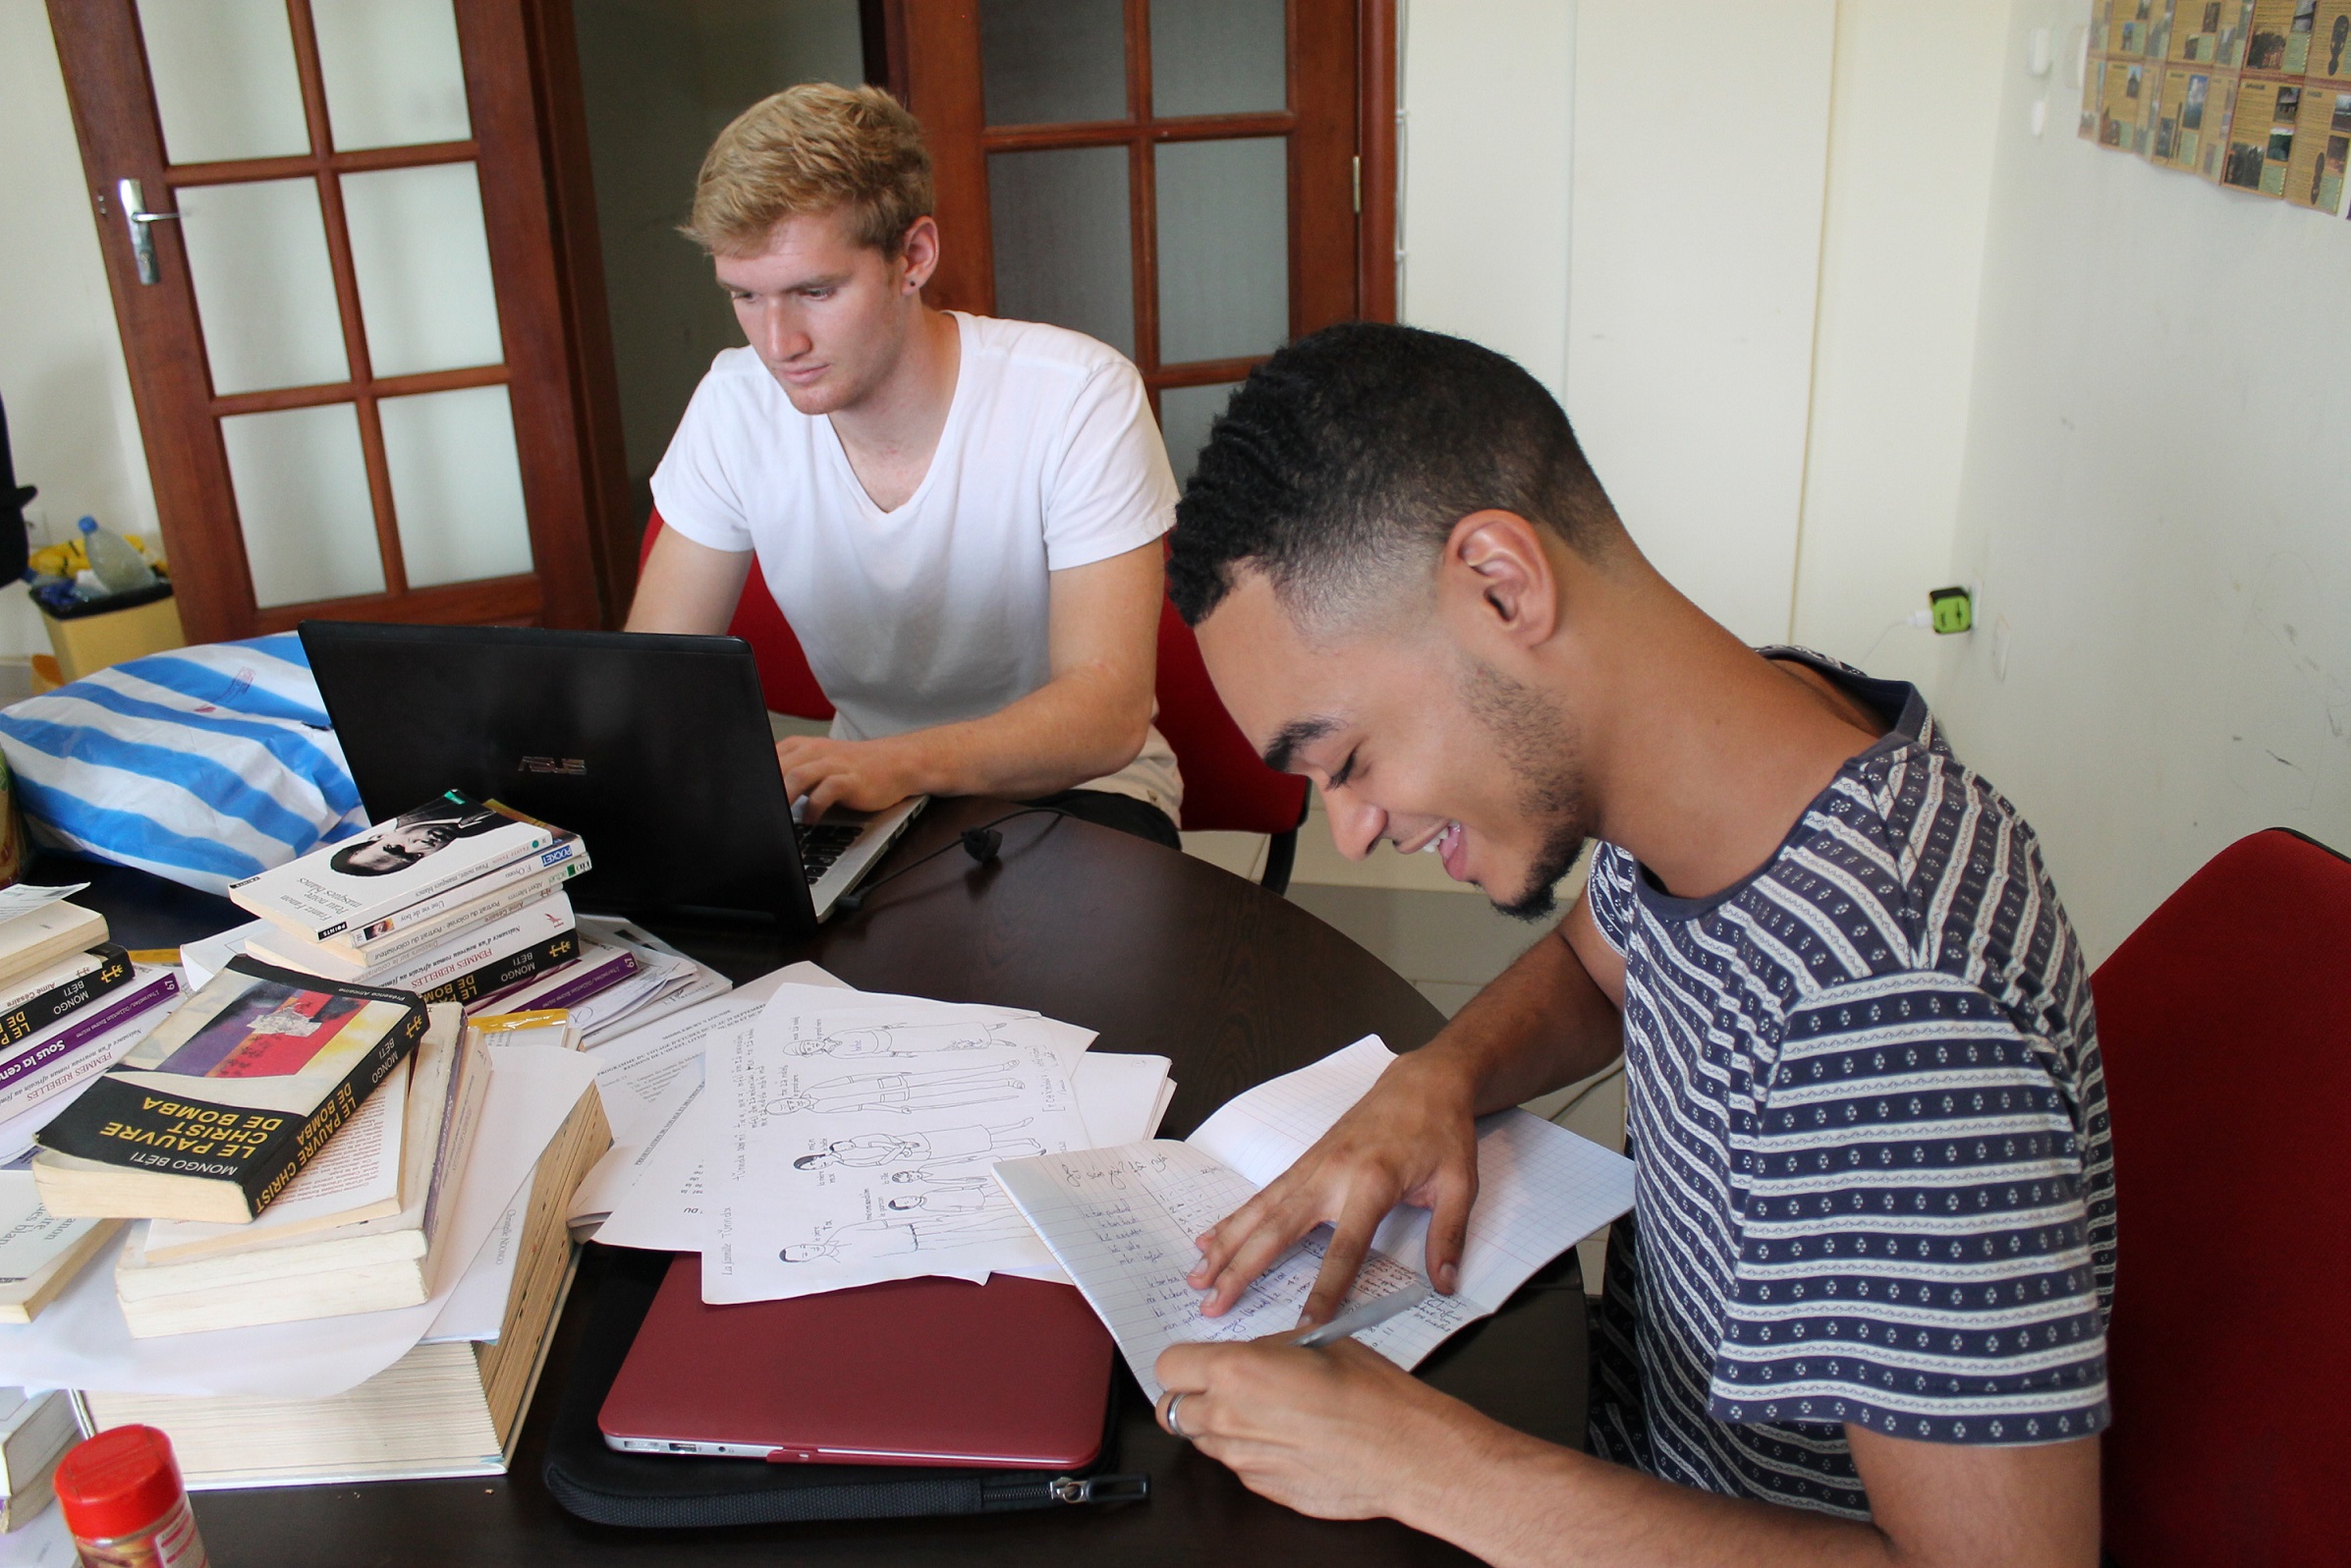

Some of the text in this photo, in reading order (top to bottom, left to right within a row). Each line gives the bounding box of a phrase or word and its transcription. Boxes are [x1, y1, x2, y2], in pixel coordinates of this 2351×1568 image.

[518, 756, 588, 775] ASUS
[541, 845, 573, 865] POCKET
[298, 876, 363, 908] masques blancs
[416, 886, 434, 897] blancs
[280, 893, 333, 922] Frantz Fanon
[328, 901, 349, 916] Peau
[400, 912, 413, 922] boy
[478, 901, 500, 915] Portrait
[322, 924, 346, 937] POINTS
[420, 927, 442, 940] Portrait
[374, 940, 411, 960] colonisateur
[411, 948, 492, 988] FEMMES REBELLES
[432, 954, 453, 966] roman
[624, 957, 635, 969] 67
[458, 974, 475, 986] DE
[501, 962, 536, 982] MONGO
[63, 980, 85, 997] BÉTI
[164, 979, 176, 991] 67
[338, 986, 406, 1002] Présence Africaine
[422, 983, 453, 1002] BOM
[462, 985, 477, 1001] LE
[7, 982, 56, 1008] Aimé Césaire
[53, 990, 89, 1016] MONGO
[7, 1010, 26, 1028] DE
[15, 1022, 30, 1039] LE
[37, 1039, 67, 1061] Sous
[22, 1055, 38, 1069] la
[371, 1050, 399, 1085] MONGO
[27, 1051, 113, 1101] FEMMES REBELLES
[140, 1095, 284, 1132] DE BOMBA
[296, 1082, 353, 1146] DE BOMBA
[99, 1121, 256, 1160] LE PAUVRE
[167, 1121, 268, 1146] CHRIST
[129, 1150, 239, 1177] MONGO BÉTI
[254, 1095, 358, 1213] LE PAUVRE CHRIST
[43, 1217, 77, 1240] anon
